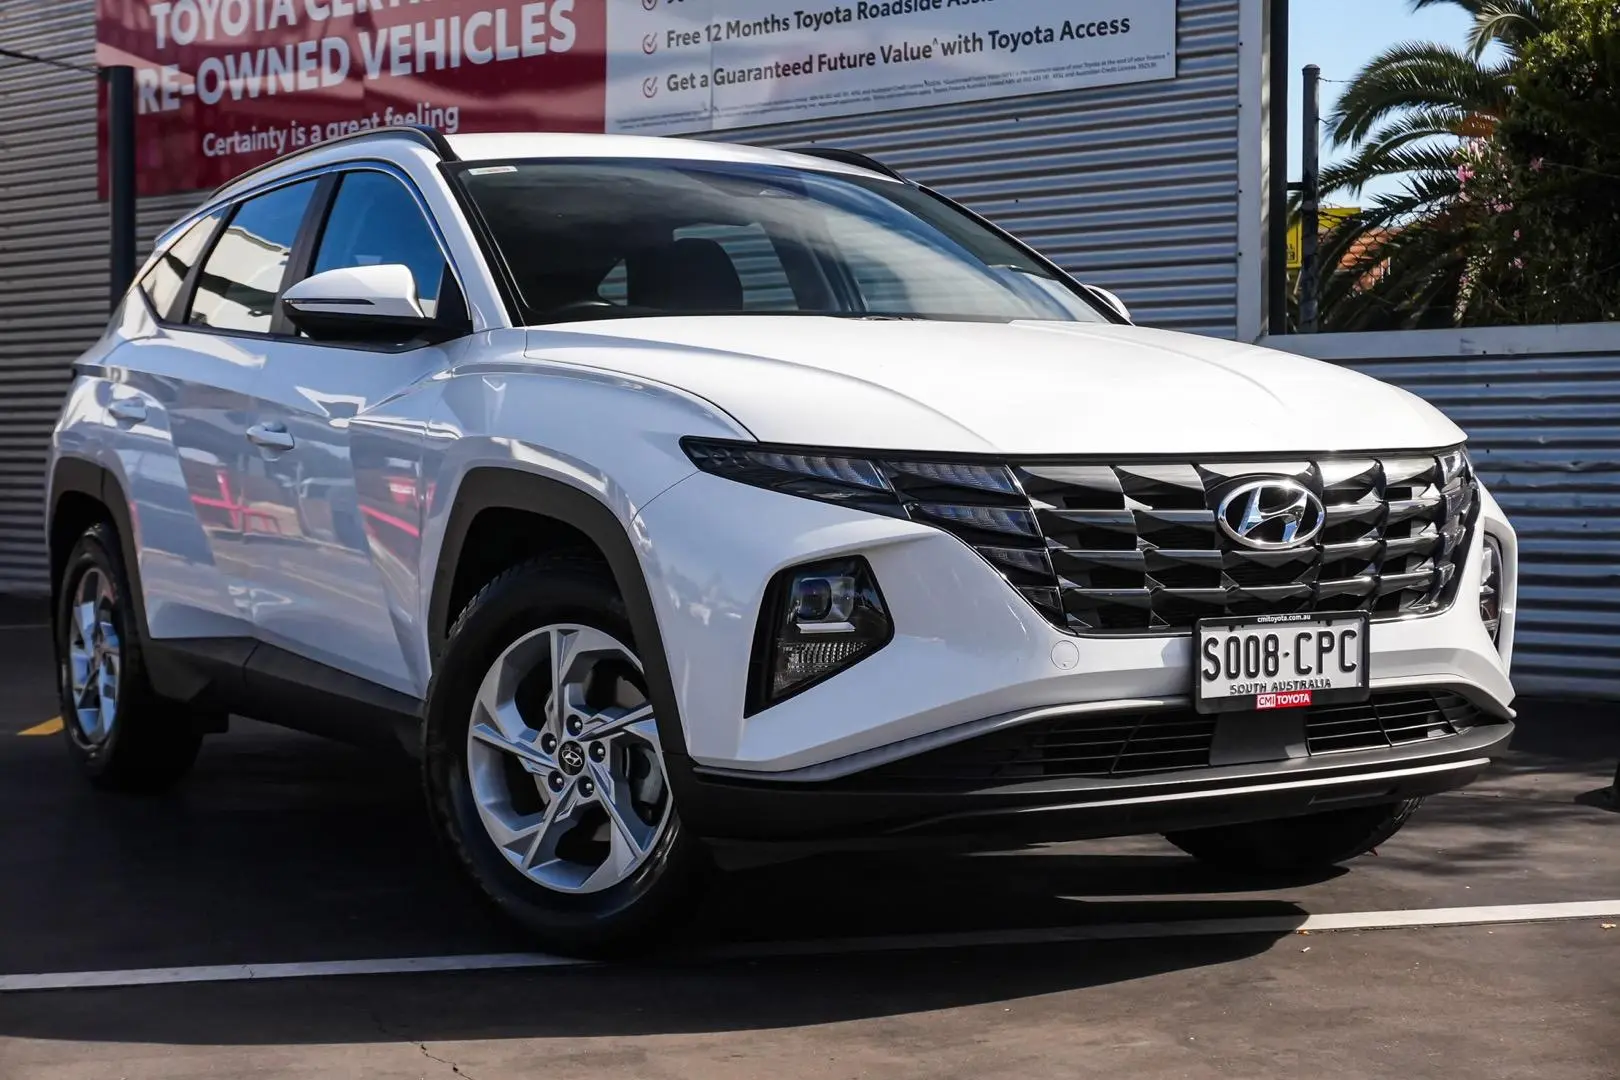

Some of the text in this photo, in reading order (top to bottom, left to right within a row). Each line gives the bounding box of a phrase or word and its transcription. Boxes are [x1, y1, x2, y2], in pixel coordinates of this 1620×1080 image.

[358, 0, 576, 80] VEHICLES
[667, 0, 942, 48] Free 12 Months Toyota Roadside
[667, 73, 697, 92] Get
[700, 75, 708, 88] a
[714, 55, 813, 86] Guaranteed
[818, 50, 876, 74] Future
[941, 32, 984, 57] with
[988, 26, 1055, 53] Toyota
[1060, 17, 1131, 41] Access
[203, 102, 459, 156] Certainty is a great feeling
[1257, 613, 1311, 623] cmitoyota.com.au
[1229, 678, 1332, 695] SOUTH AUSTRALIA
[1277, 694, 1311, 704] TOYOTA
